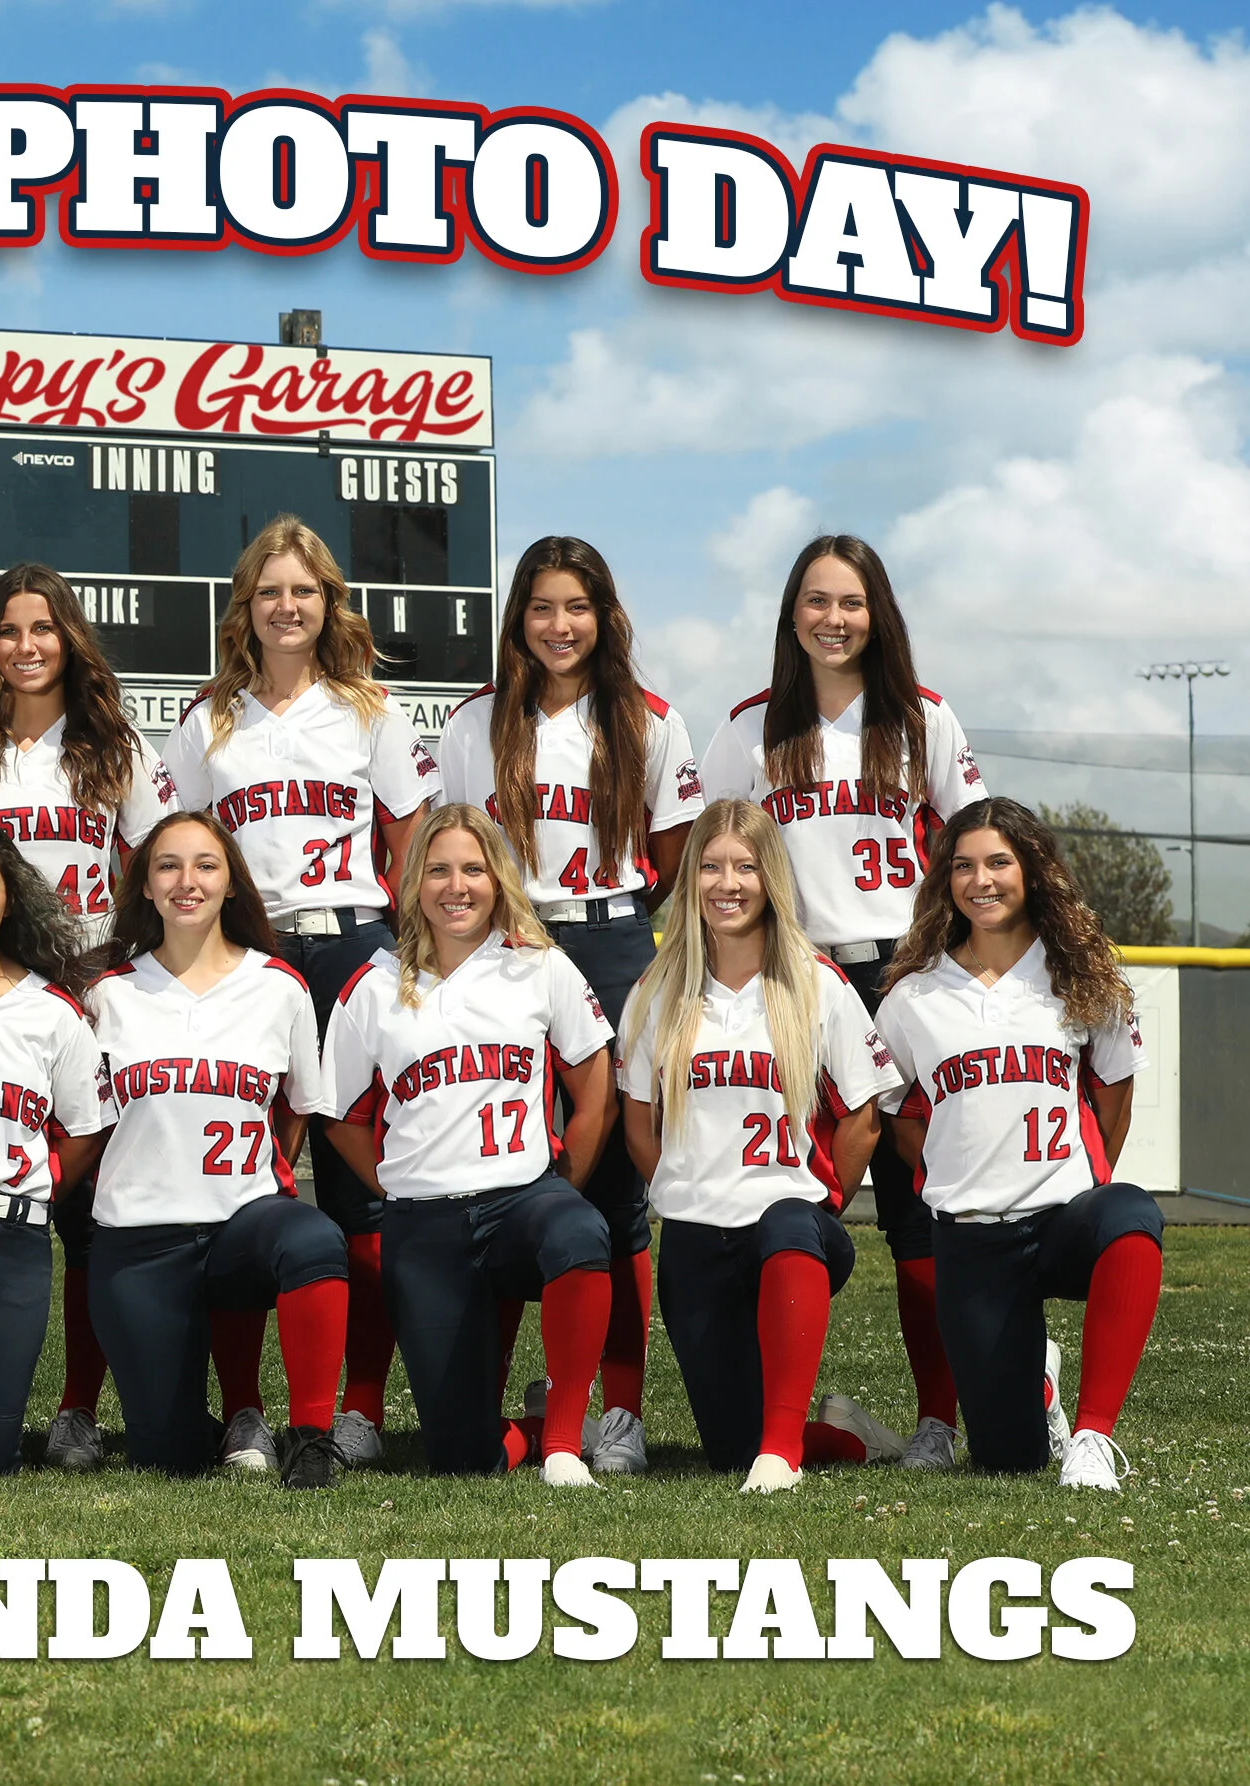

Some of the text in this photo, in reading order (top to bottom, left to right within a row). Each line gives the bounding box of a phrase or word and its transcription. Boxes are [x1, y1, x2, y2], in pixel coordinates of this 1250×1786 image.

[174, 342, 484, 442] Garage
[92, 446, 215, 494] INNING
[340, 457, 458, 505] GUESTS
[70, 585, 139, 625] RIKE
[393, 596, 467, 635] H E
[216, 779, 358, 834] MUSTANGS
[55, 863, 109, 915] 42
[852, 837, 915, 892] 35
[113, 1057, 271, 1109] MUSTANGS
[391, 1043, 535, 1106] MUSTANGS
[931, 1045, 1072, 1106] MUSTANGS
[202, 1120, 266, 1175] 27
[478, 1098, 528, 1157] 17
[742, 1112, 801, 1168] 20
[1023, 1106, 1071, 1162] 12
[4, 1143, 32, 1187] 7
